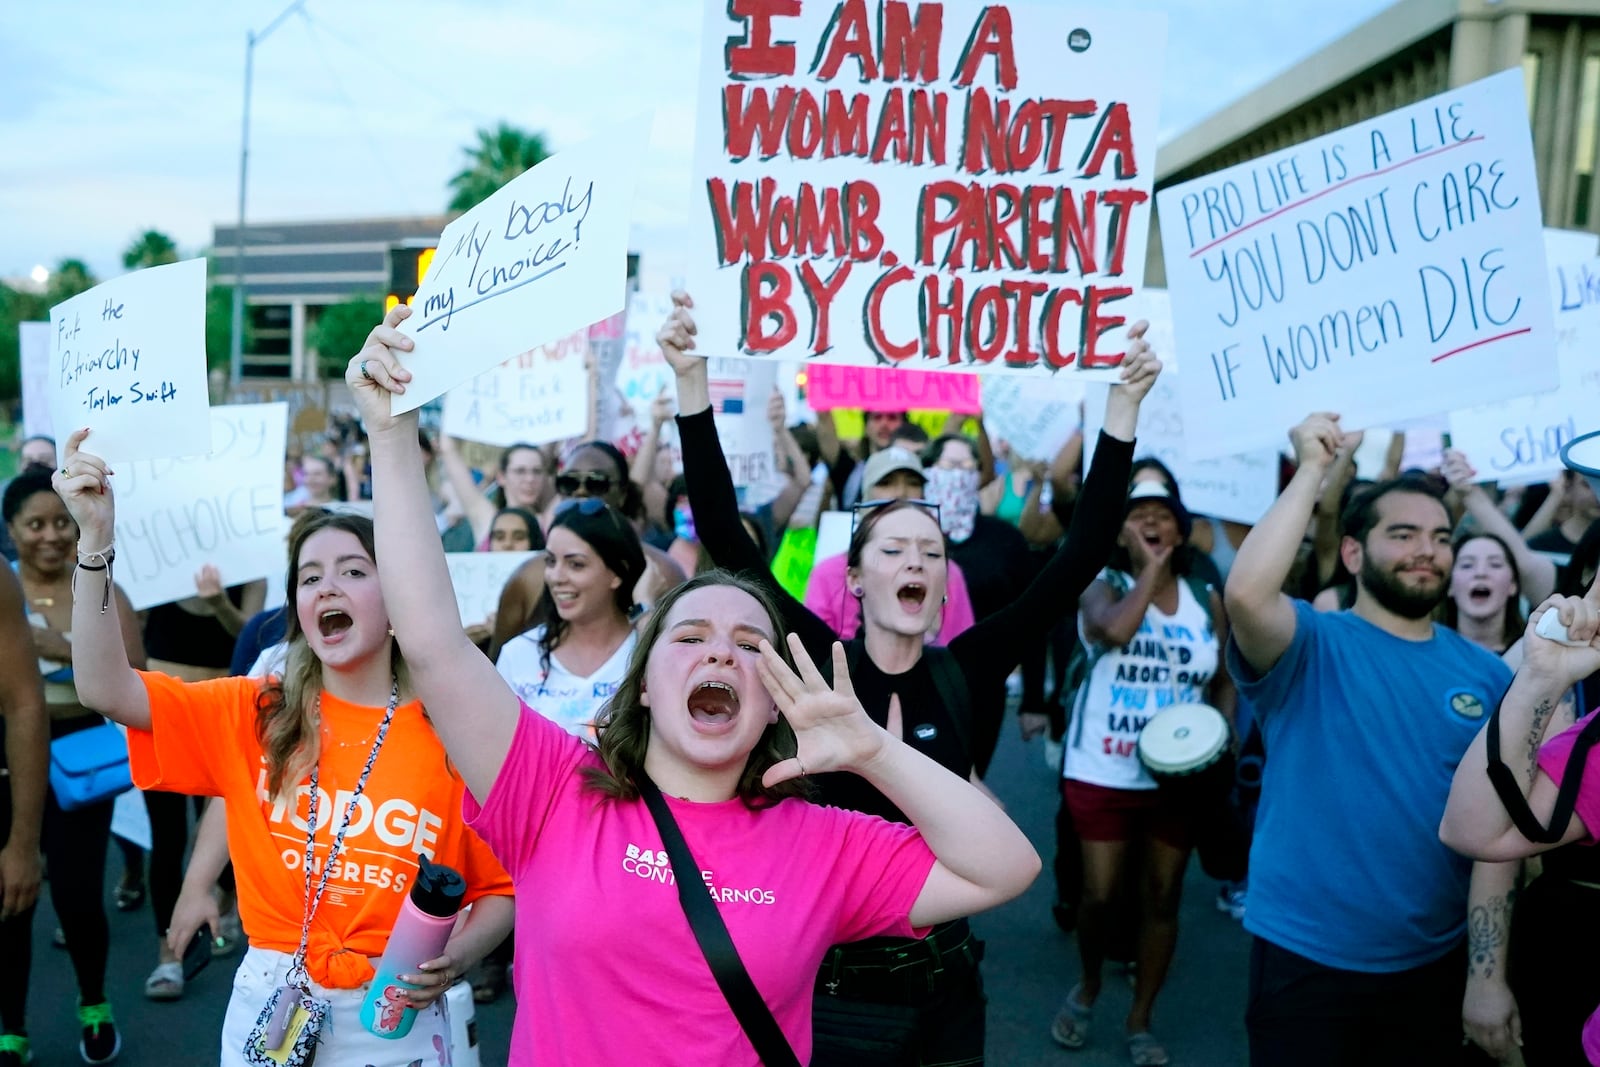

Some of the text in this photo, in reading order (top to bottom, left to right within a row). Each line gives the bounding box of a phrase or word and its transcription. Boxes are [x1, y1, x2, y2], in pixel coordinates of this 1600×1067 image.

[726, 0, 1017, 92] I AM A
[722, 83, 1138, 179] WOMAN NOT A
[1182, 102, 1475, 248] PRO LIFE IS A LIE
[433, 175, 593, 287] My body
[915, 180, 1149, 276] PARENT
[1204, 159, 1519, 328] YOU DONT CARE
[102, 297, 124, 320] the
[424, 287, 454, 331] my
[738, 261, 852, 356] BY
[863, 264, 1133, 373] CHOICE
[1211, 342, 1241, 400] IF
[1419, 247, 1521, 343] DIE
[61, 338, 140, 389] Patriarchy
[130, 381, 177, 404] Swift
[1490, 413, 1578, 472] School
[281, 848, 408, 894] ONGRESS
